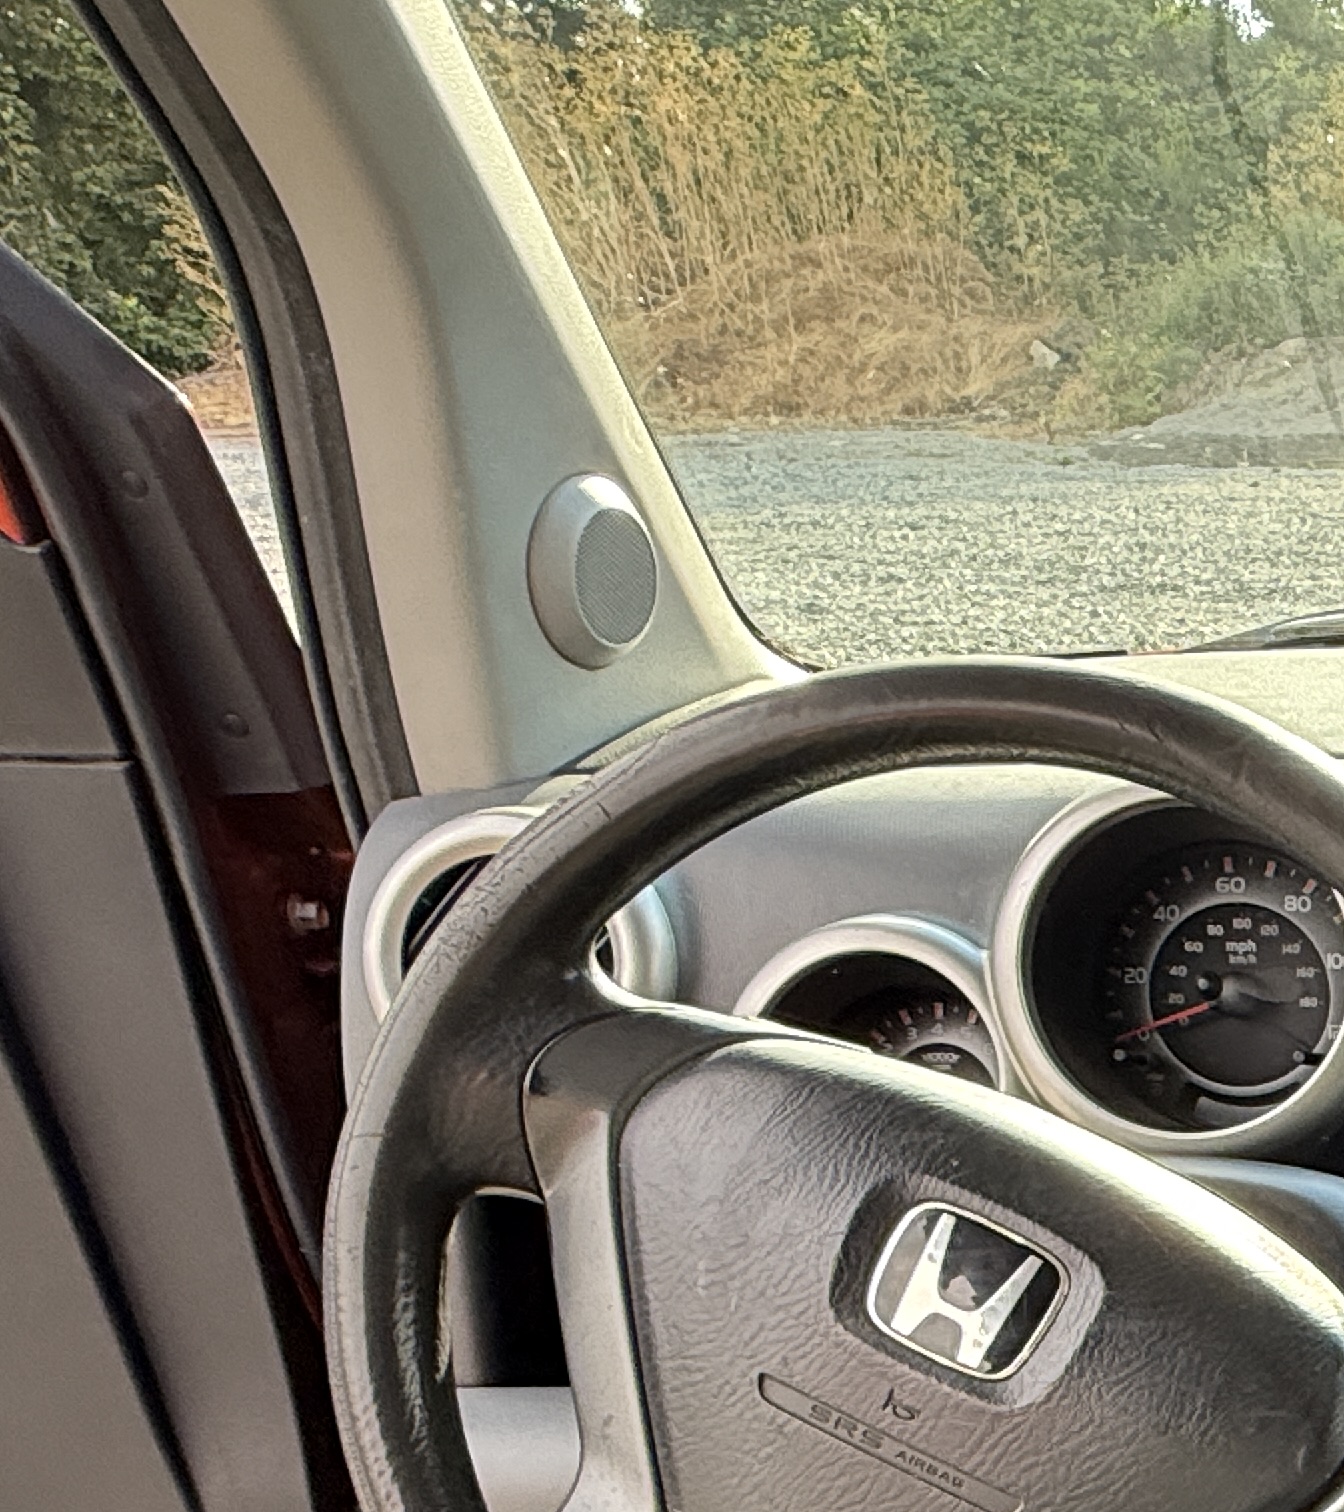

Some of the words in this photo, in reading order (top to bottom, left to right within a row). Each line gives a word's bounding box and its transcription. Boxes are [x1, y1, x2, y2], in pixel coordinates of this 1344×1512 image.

[1215, 876, 1246, 893] 60
[1284, 896, 1312, 913] 80
[1153, 904, 1180, 922] 40
[1184, 942, 1204, 954] 60
[1225, 939, 1257, 954] mph
[1124, 968, 1147, 984] 20
[1168, 965, 1187, 977] 40
[907, 1026, 917, 1040] 3
[931, 1023, 944, 1036] 4
[808, 1403, 886, 1451] SRS
[893, 1448, 967, 1490] AIRBAG
